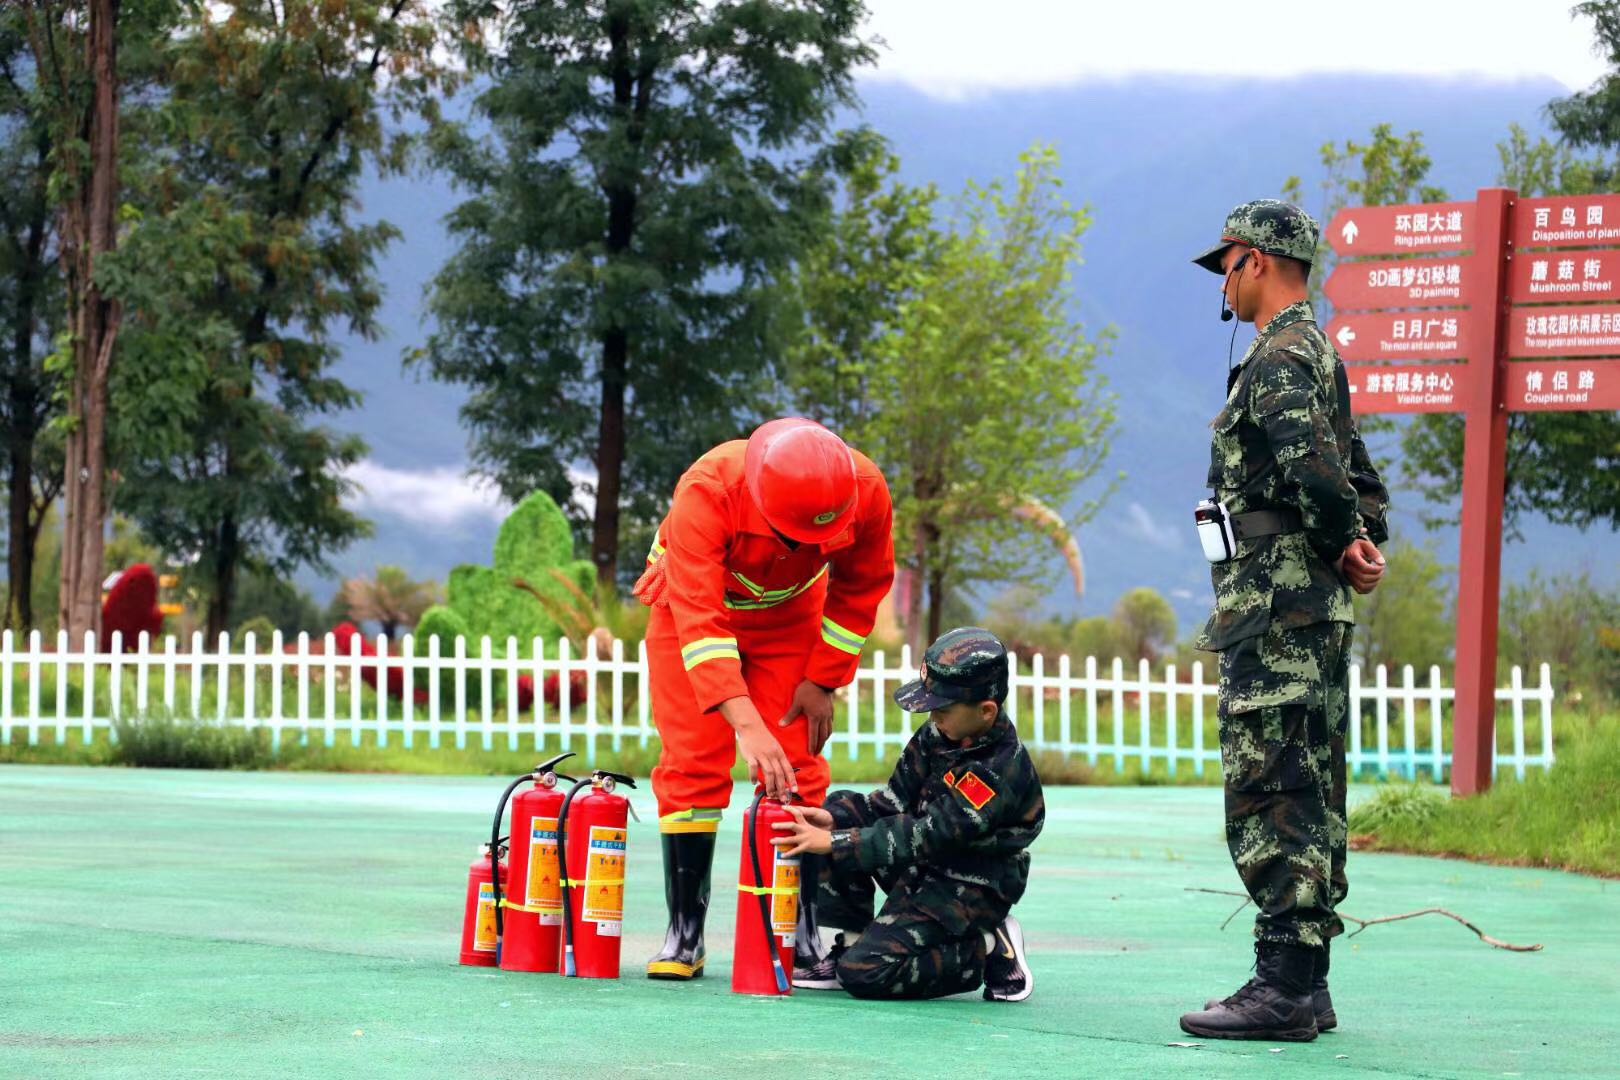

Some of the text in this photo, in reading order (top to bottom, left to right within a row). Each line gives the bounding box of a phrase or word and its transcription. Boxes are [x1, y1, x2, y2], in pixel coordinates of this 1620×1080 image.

[1395, 210, 1462, 232] 环园大道
[1533, 205, 1603, 228] 百鸟园
[1395, 234, 1462, 246] Ring park avenue
[1532, 229, 1585, 241] Disposition
[1587, 228, 1597, 239] of
[1368, 264, 1461, 288] 3D画梦幻秘境
[1532, 258, 1601, 280] 蘑菇街
[1409, 287, 1460, 299] 3D painting
[1530, 280, 1612, 293] Mushroom Street
[1393, 318, 1458, 339] 日月广场
[1380, 340, 1393, 351] The
[1366, 372, 1454, 393] 游客服务中心
[1397, 393, 1453, 405] Visitor Center
[1524, 391, 1588, 405] Couples road
